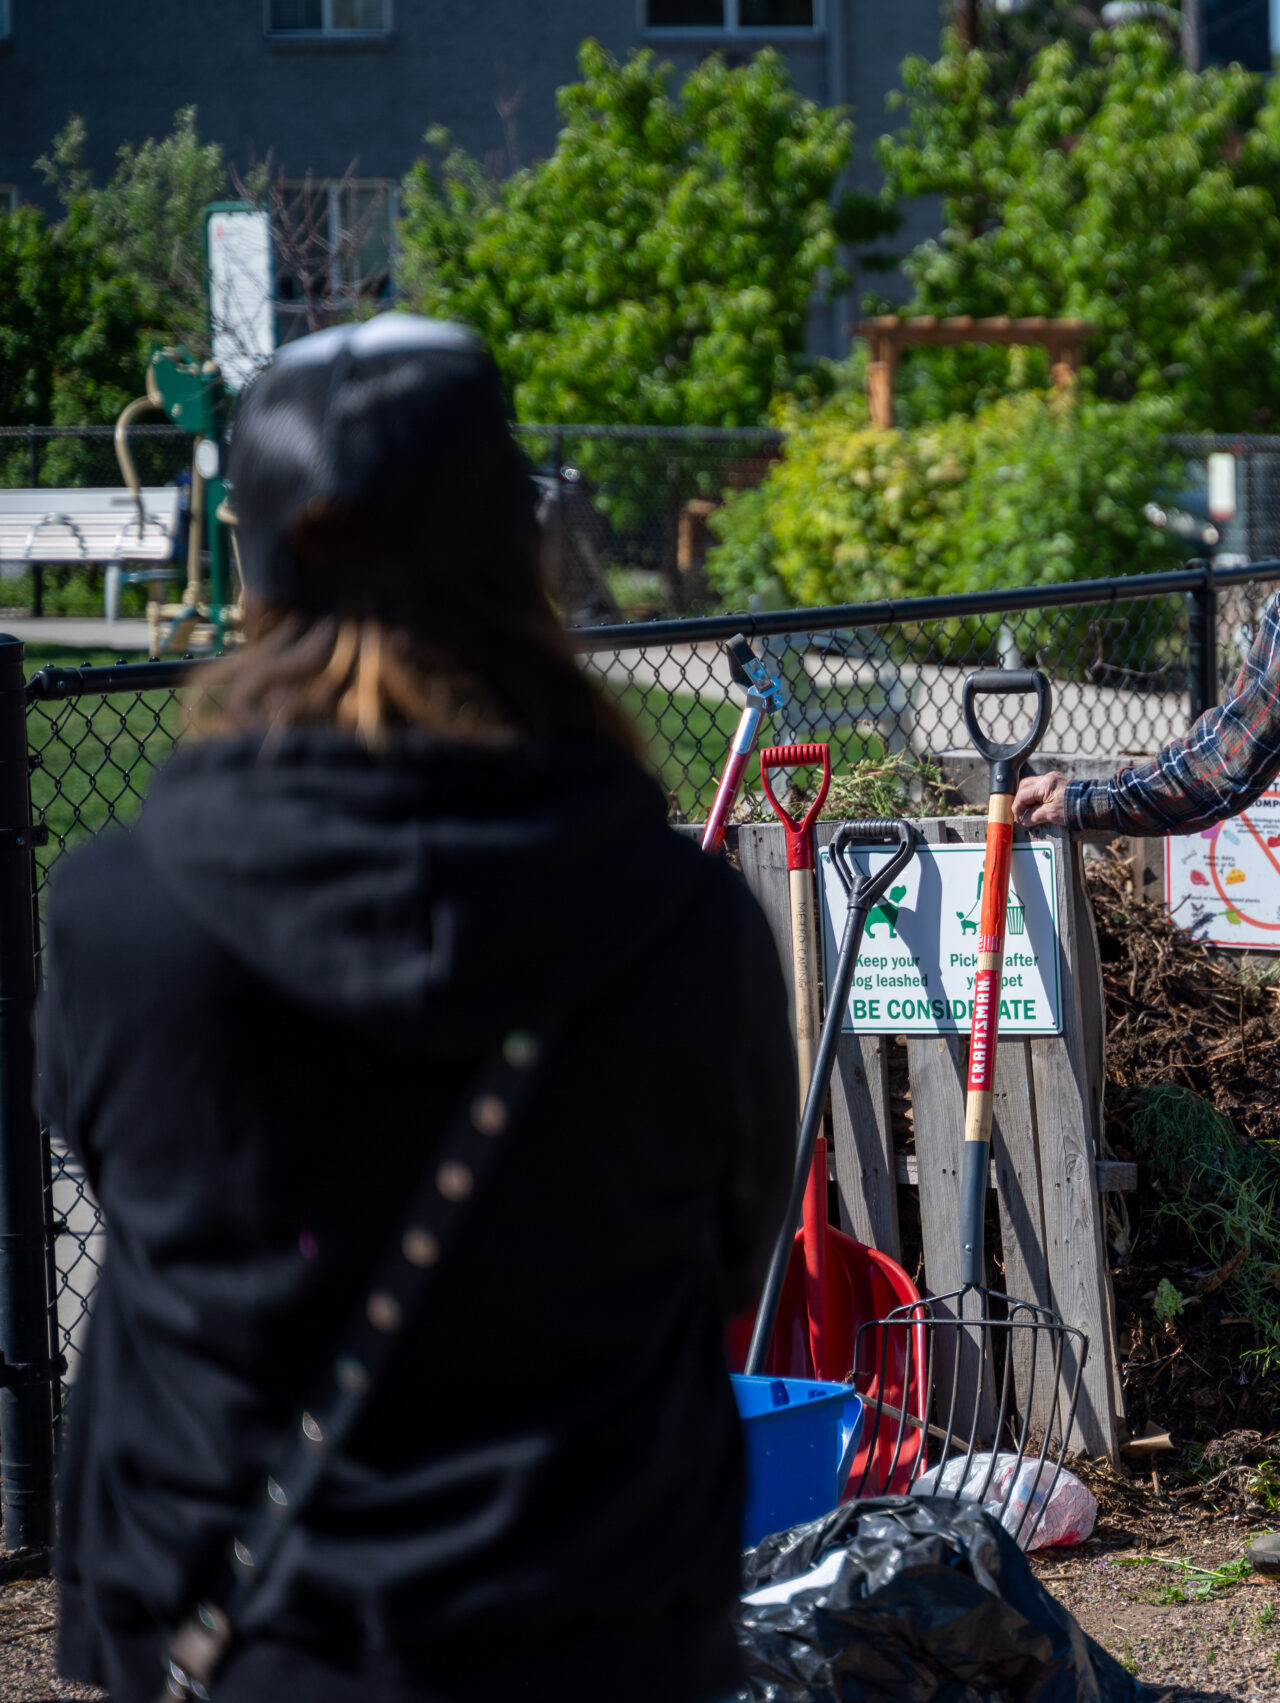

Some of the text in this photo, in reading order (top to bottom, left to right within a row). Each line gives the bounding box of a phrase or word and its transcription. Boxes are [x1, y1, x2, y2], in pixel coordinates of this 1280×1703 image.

[856, 954, 921, 970] Keep your
[950, 953, 1038, 967] Pick after
[876, 973, 928, 987] leashed
[1001, 974, 1023, 990] pet
[853, 999, 1036, 1020] BE CONSIDATE
[971, 978, 991, 1084] CRAFTSMAN
